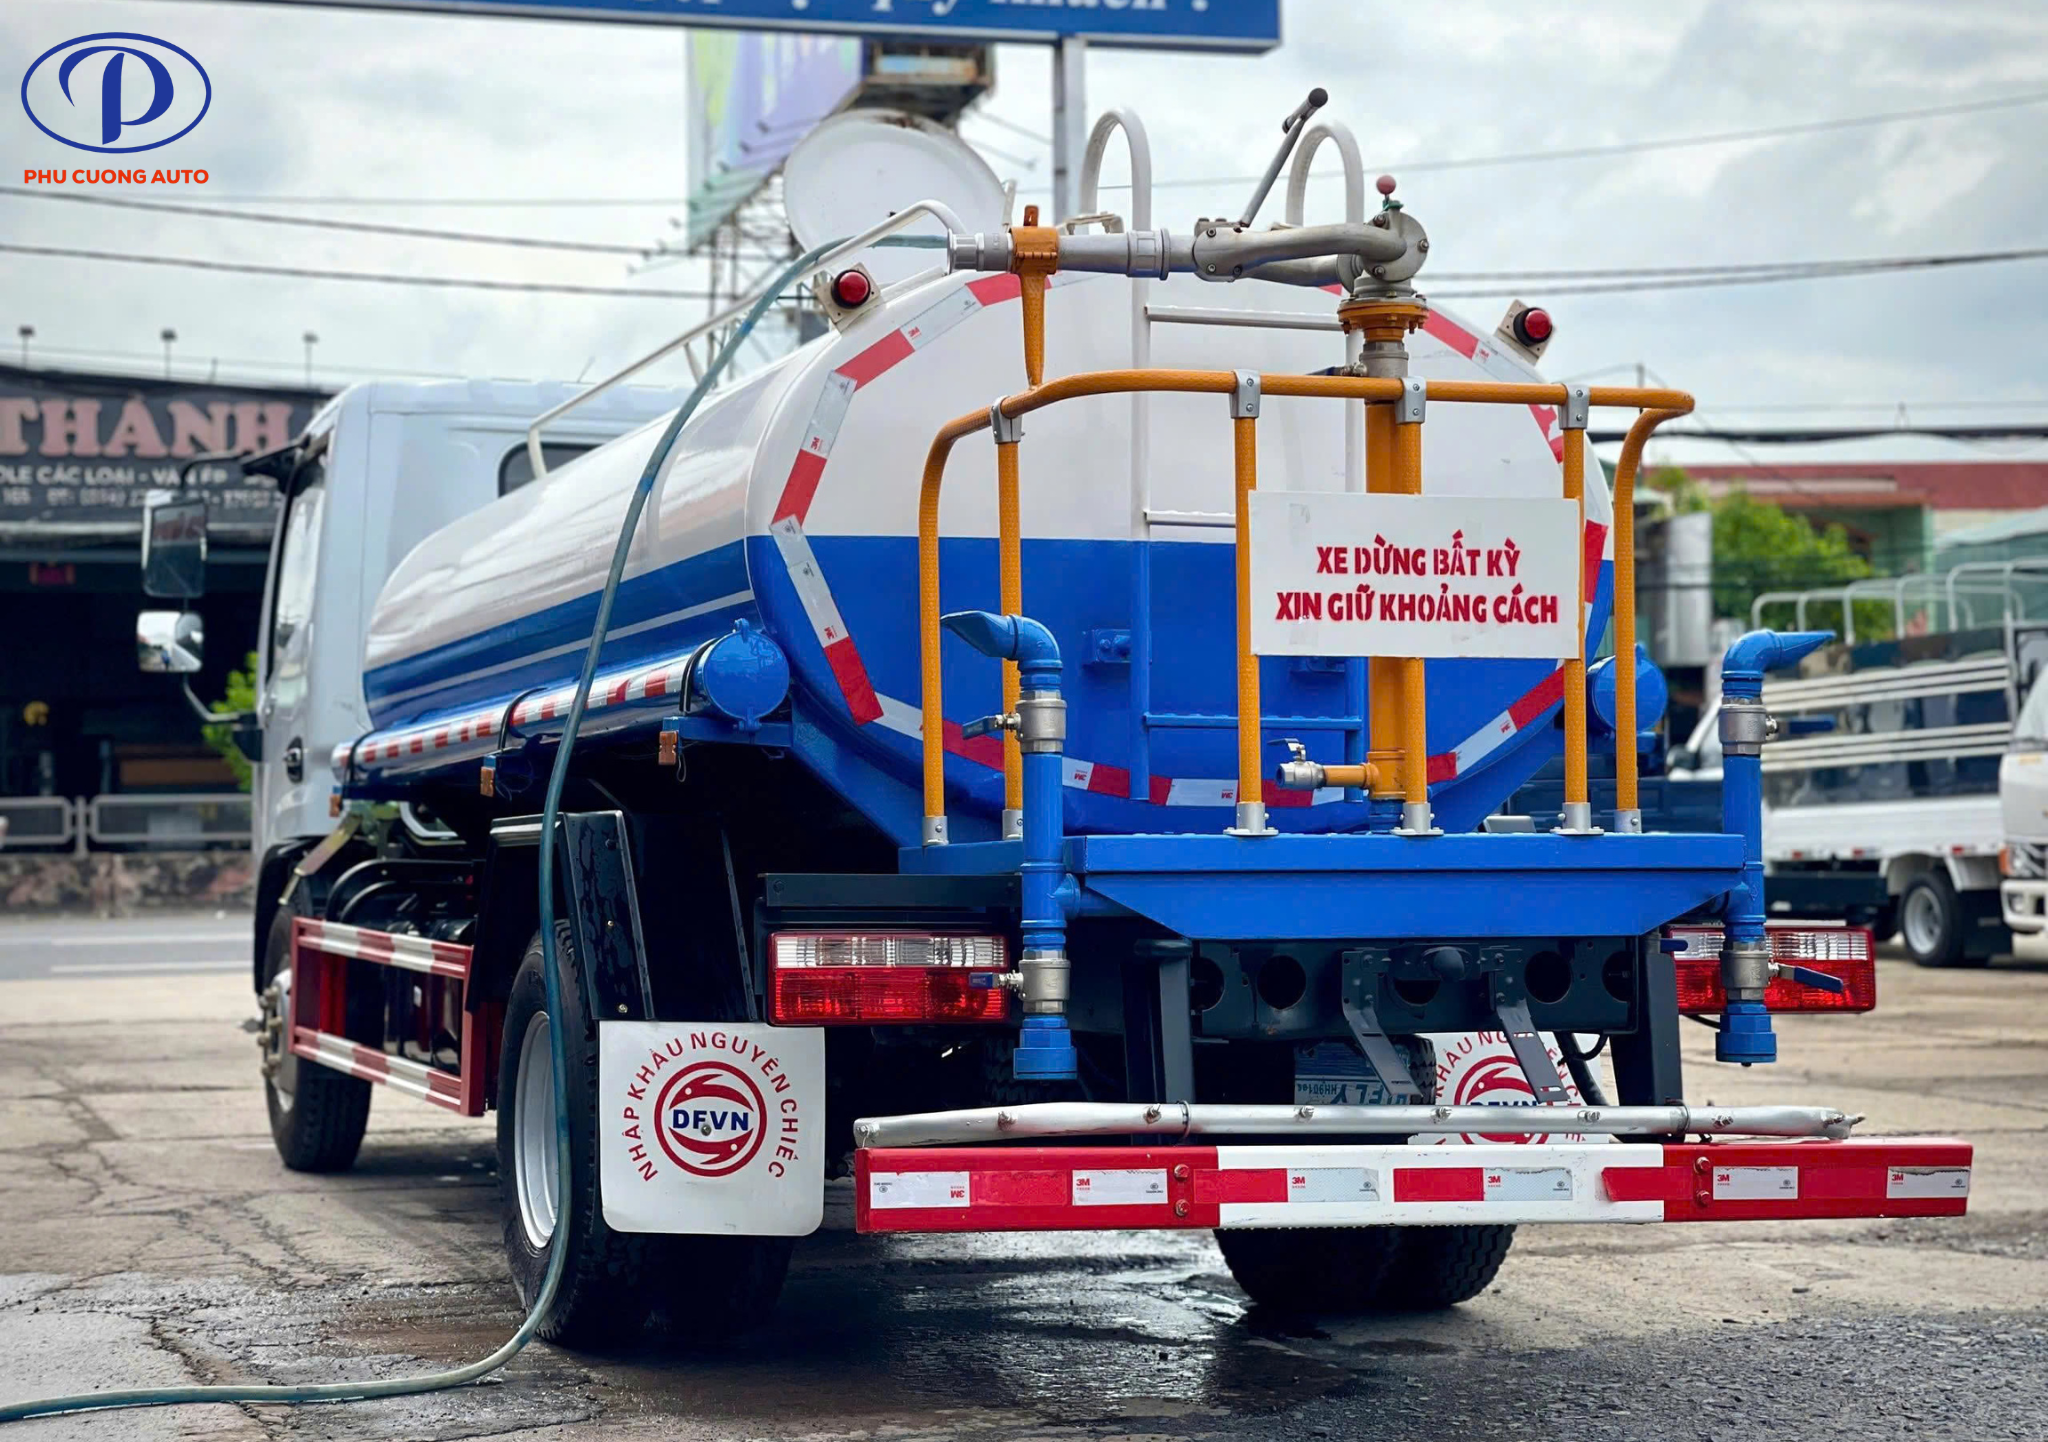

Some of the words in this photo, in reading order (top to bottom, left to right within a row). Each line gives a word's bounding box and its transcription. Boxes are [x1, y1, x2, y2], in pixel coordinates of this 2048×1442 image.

[1317, 546, 1348, 574] XE
[1354, 533, 1427, 577] DỪNG
[1434, 529, 1481, 577] BẤT
[1487, 537, 1521, 577] KỲ
[1276, 592, 1322, 621] XIN
[1327, 583, 1376, 622] GIỮ
[1379, 582, 1488, 623] KHOẢNG
[1493, 582, 1559, 624] CÁCH
[672, 1109, 749, 1131] DFVN
[1292, 1176, 1306, 1184] 3M
[1488, 1175, 1501, 1183] 3M
[1717, 1174, 1730, 1182] 3M
[1891, 1173, 1904, 1181] 3M
[1076, 1178, 1090, 1186] 3M
